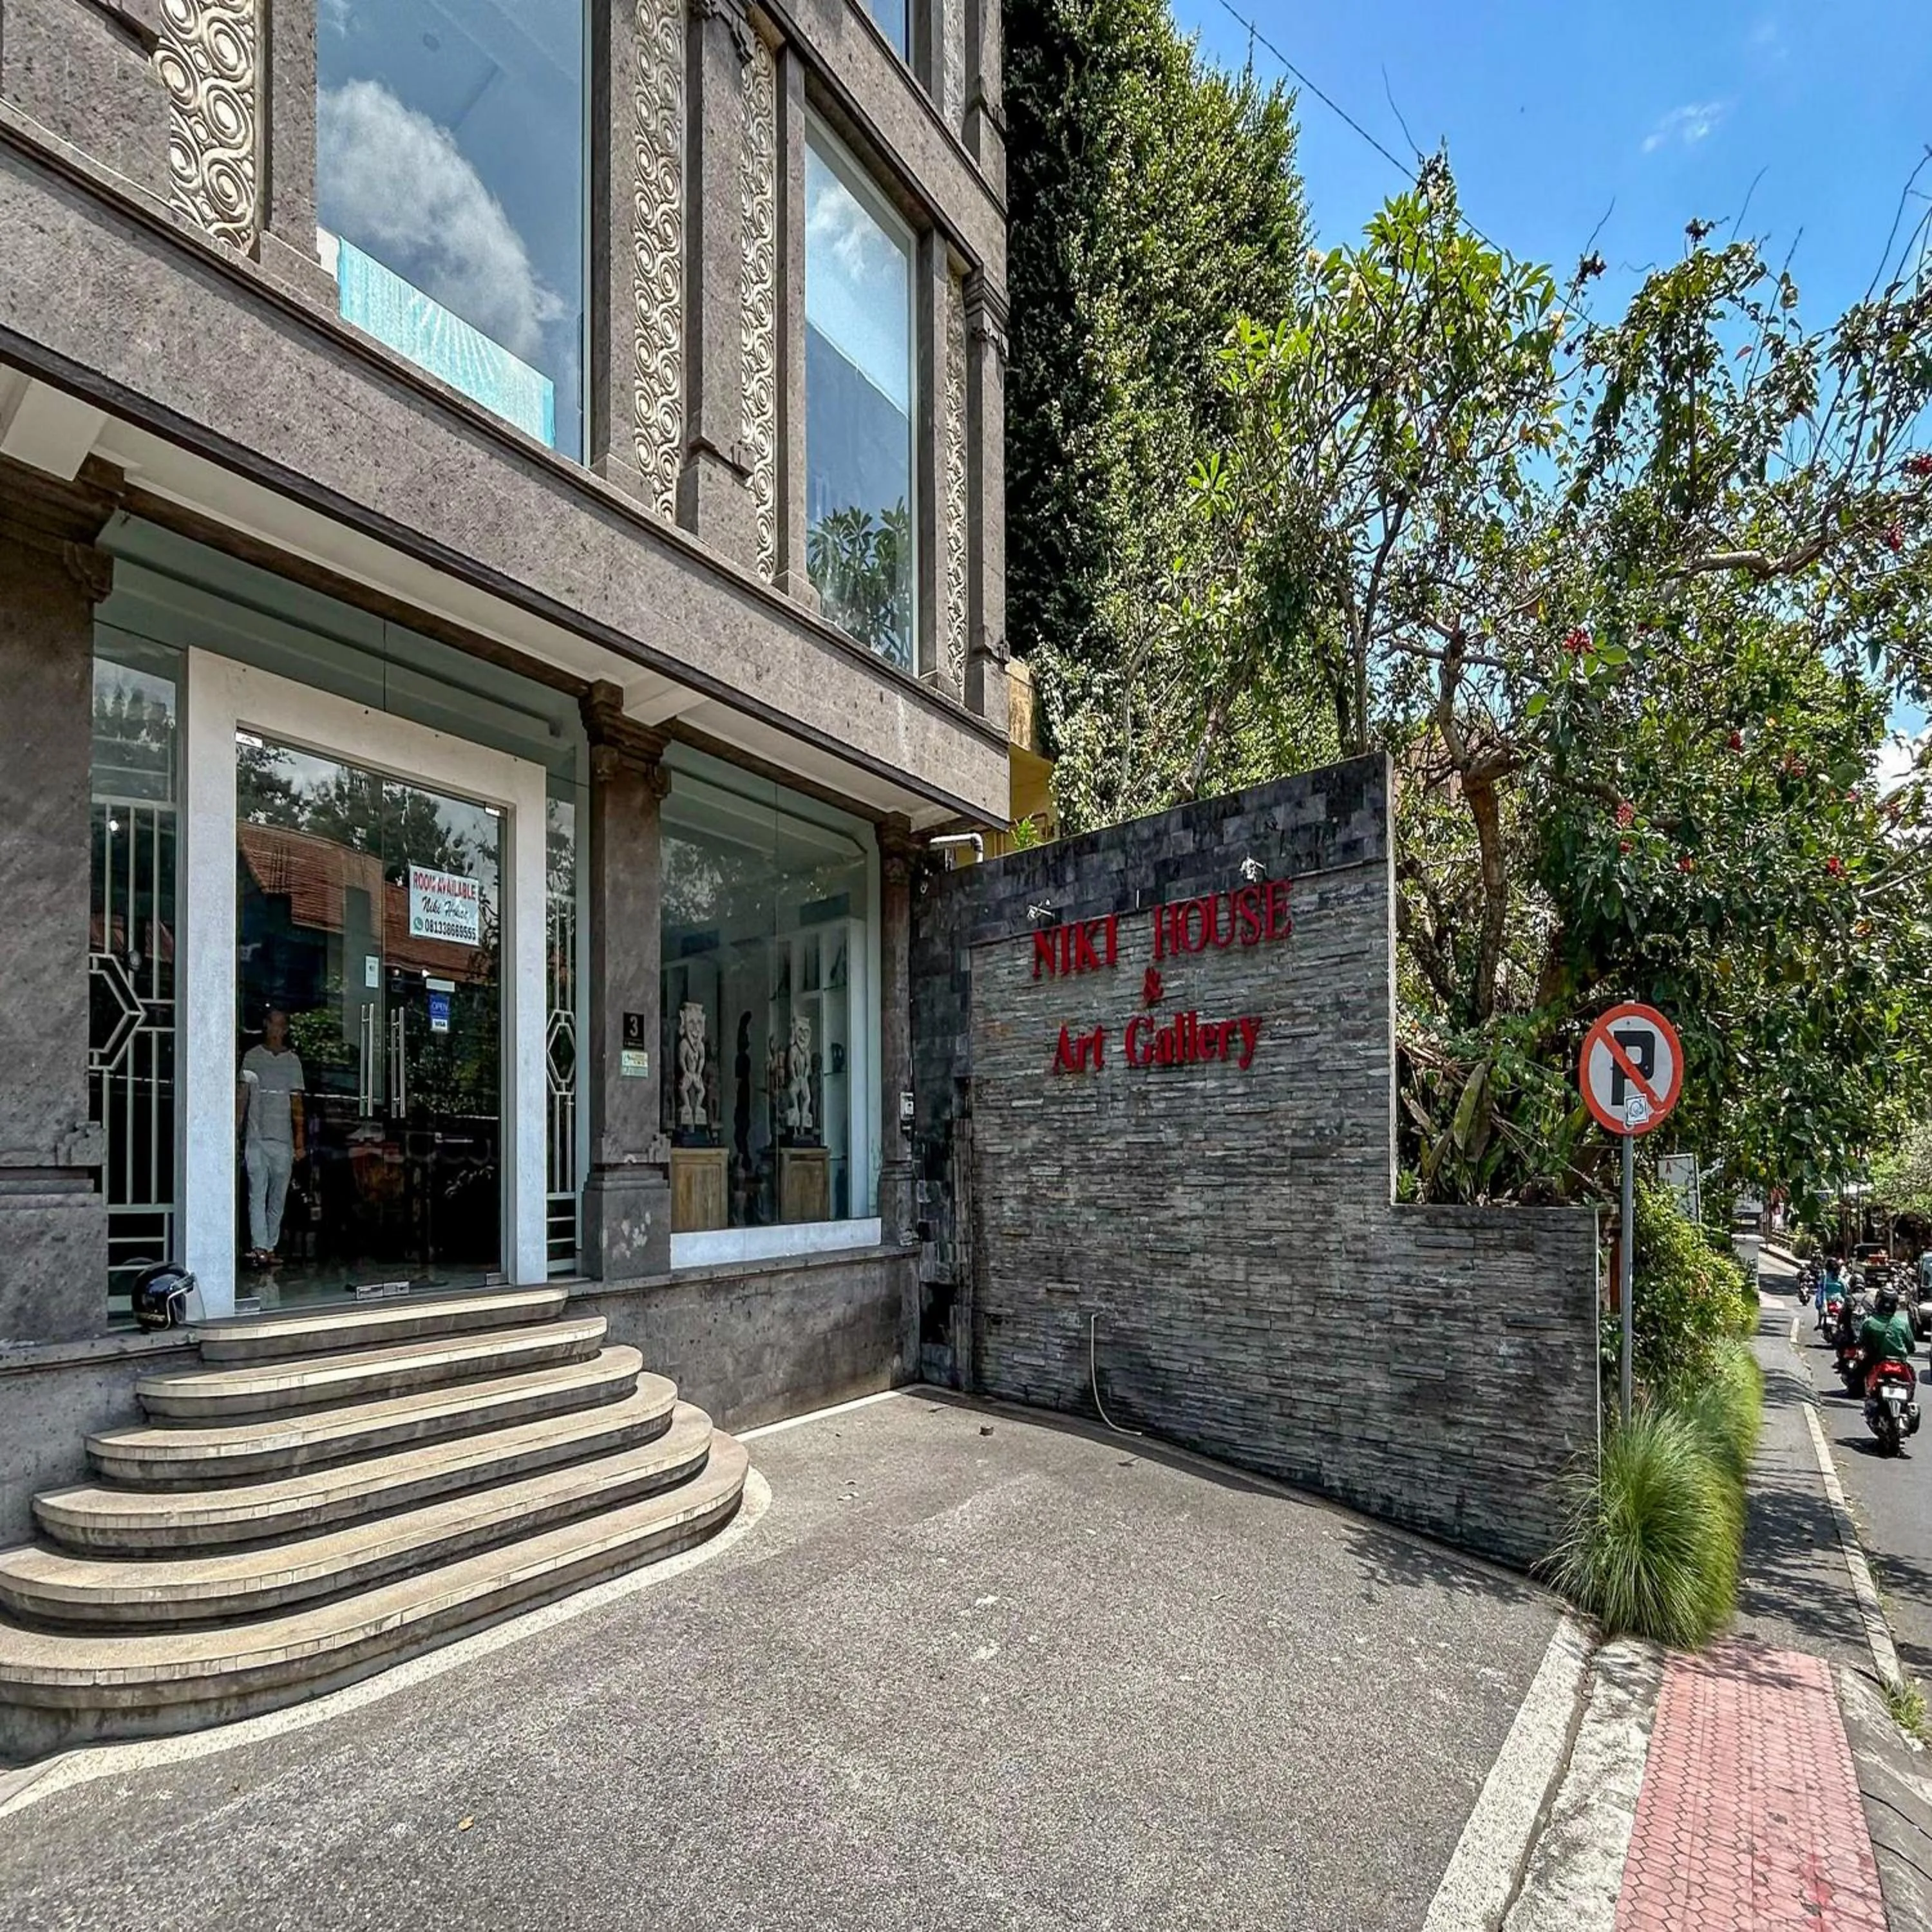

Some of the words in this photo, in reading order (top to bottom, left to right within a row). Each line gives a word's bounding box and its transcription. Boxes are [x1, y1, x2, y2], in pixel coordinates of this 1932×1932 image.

[413, 871, 437, 893] ROOM
[437, 876, 476, 900] AVAILABLE
[1033, 913, 1119, 980] NIKI
[1152, 878, 1293, 959] HOUSE
[1142, 967, 1164, 1006] &
[629, 1016, 638, 1037] 3
[1053, 1021, 1107, 1075] Art
[1124, 1010, 1262, 1071] Gallery
[1611, 1030, 1655, 1106] P
